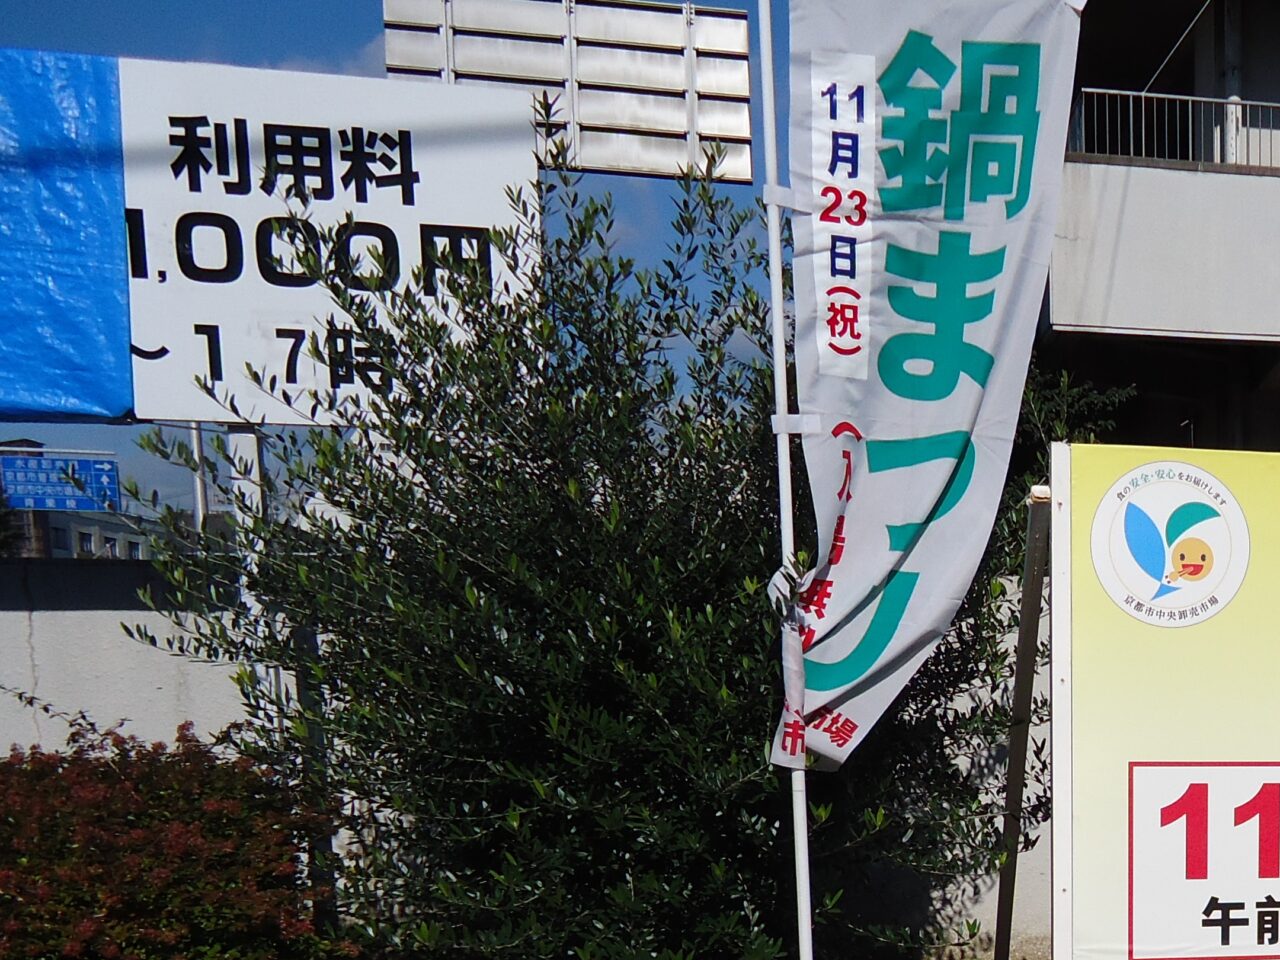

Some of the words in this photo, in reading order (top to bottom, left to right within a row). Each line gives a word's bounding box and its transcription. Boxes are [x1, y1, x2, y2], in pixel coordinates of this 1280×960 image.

[168, 115, 420, 206] 利用料
[820, 82, 868, 356] 11月23日(祝)
[1116, 468, 1227, 506] 食の安全・安心をお届けします
[1123, 595, 1220, 622] 京都市中央卸売市場
